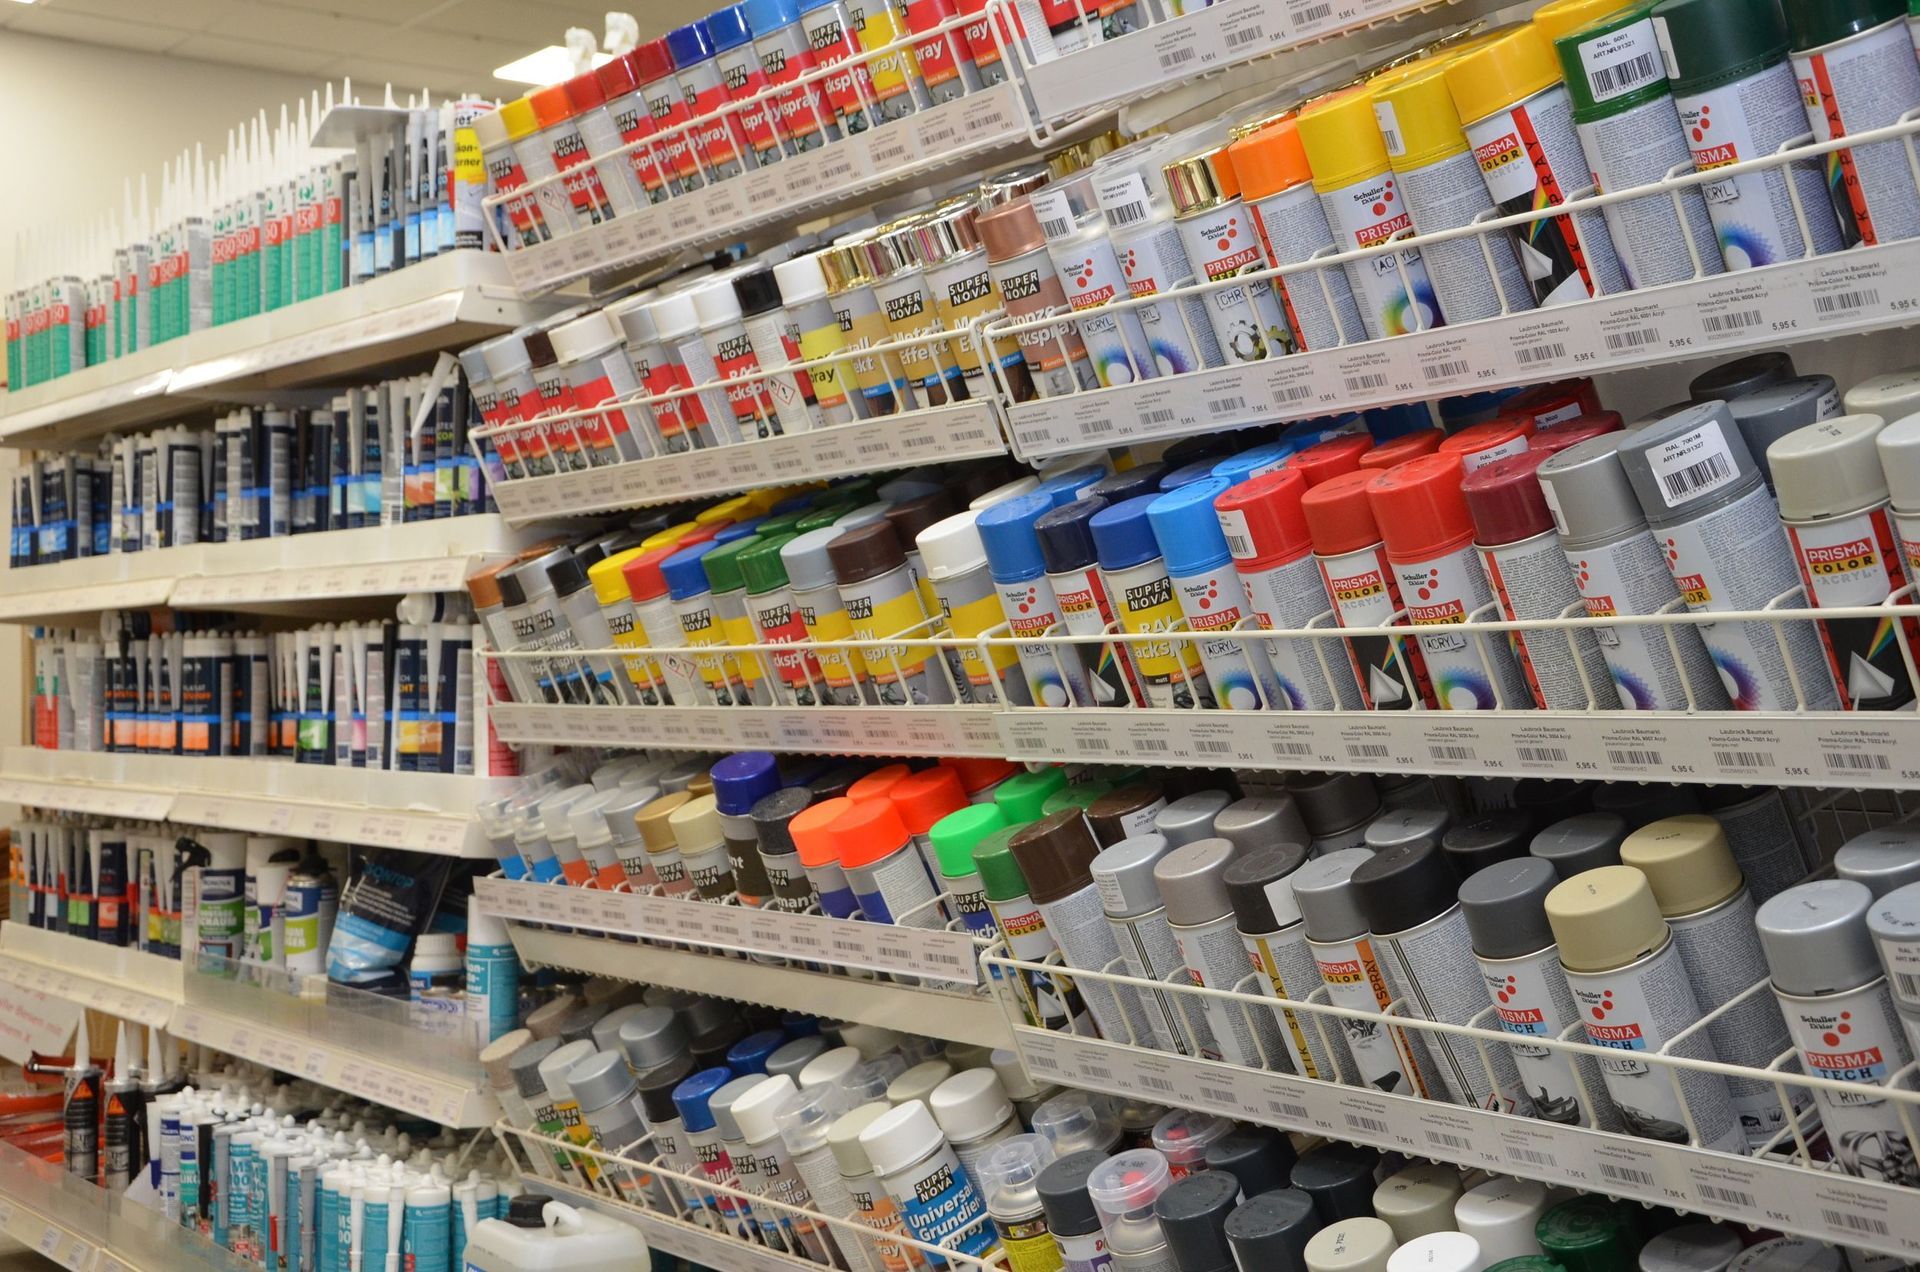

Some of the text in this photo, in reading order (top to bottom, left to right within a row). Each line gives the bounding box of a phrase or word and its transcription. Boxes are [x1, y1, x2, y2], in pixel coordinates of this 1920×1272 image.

[810, 21, 840, 41] SUPER
[813, 33, 841, 50] NOVA
[1597, 40, 1611, 49] RAL
[1475, 137, 1516, 162] PRISMA
[1481, 149, 1521, 172] COLOR
[1353, 187, 1384, 202] Schuller
[1201, 223, 1229, 238] Schuller
[1208, 250, 1257, 274] PRISMA
[949, 272, 989, 304] SUPER
[1002, 272, 1038, 292] SUPER
[952, 284, 991, 307] NOVA
[1004, 283, 1040, 301] NOVA
[1072, 289, 1114, 309] PRISMA
[887, 293, 921, 314] SUPER
[890, 304, 924, 322] NOVA
[1087, 317, 1114, 333] ACRYL
[1791, 319, 1798, 327] €
[1686, 337, 1693, 345] €
[1665, 444, 1680, 453] RAL
[1808, 544, 1870, 563] PRISMA
[1813, 555, 1874, 575] COLOR
[1334, 574, 1379, 590] PRISMA
[1402, 572, 1428, 583] Schuller
[1127, 578, 1170, 600] SUPER
[1184, 584, 1210, 595] Schuller
[1339, 584, 1382, 600] COLOR
[1057, 593, 1089, 605] PRISMA
[1130, 593, 1171, 611] NOVA
[1062, 602, 1093, 613] COLOR
[1411, 602, 1458, 619] PRISMA
[1011, 616, 1053, 630] PRISMA
[1191, 610, 1239, 629] PRISMA
[1427, 635, 1460, 651] ACRYL
[1804, 768, 1811, 776] €
[953, 893, 985, 907] SUPER
[958, 902, 987, 913] NOVA
[1005, 912, 1041, 928] PRISMA
[1008, 923, 1046, 937] COLOR
[1319, 961, 1358, 975] PRISMA
[1324, 973, 1363, 985] COLOR
[1576, 989, 1602, 1000] Schuller
[1801, 1015, 1837, 1024] Schuller
[1587, 1022, 1637, 1040] PRISMA
[1808, 1051, 1876, 1069] PRISMA
[1819, 1067, 1873, 1080] TECH
[915, 1164, 952, 1194] SUPER
[919, 1177, 954, 1203] NOVA
[909, 1181, 973, 1229] Universal
